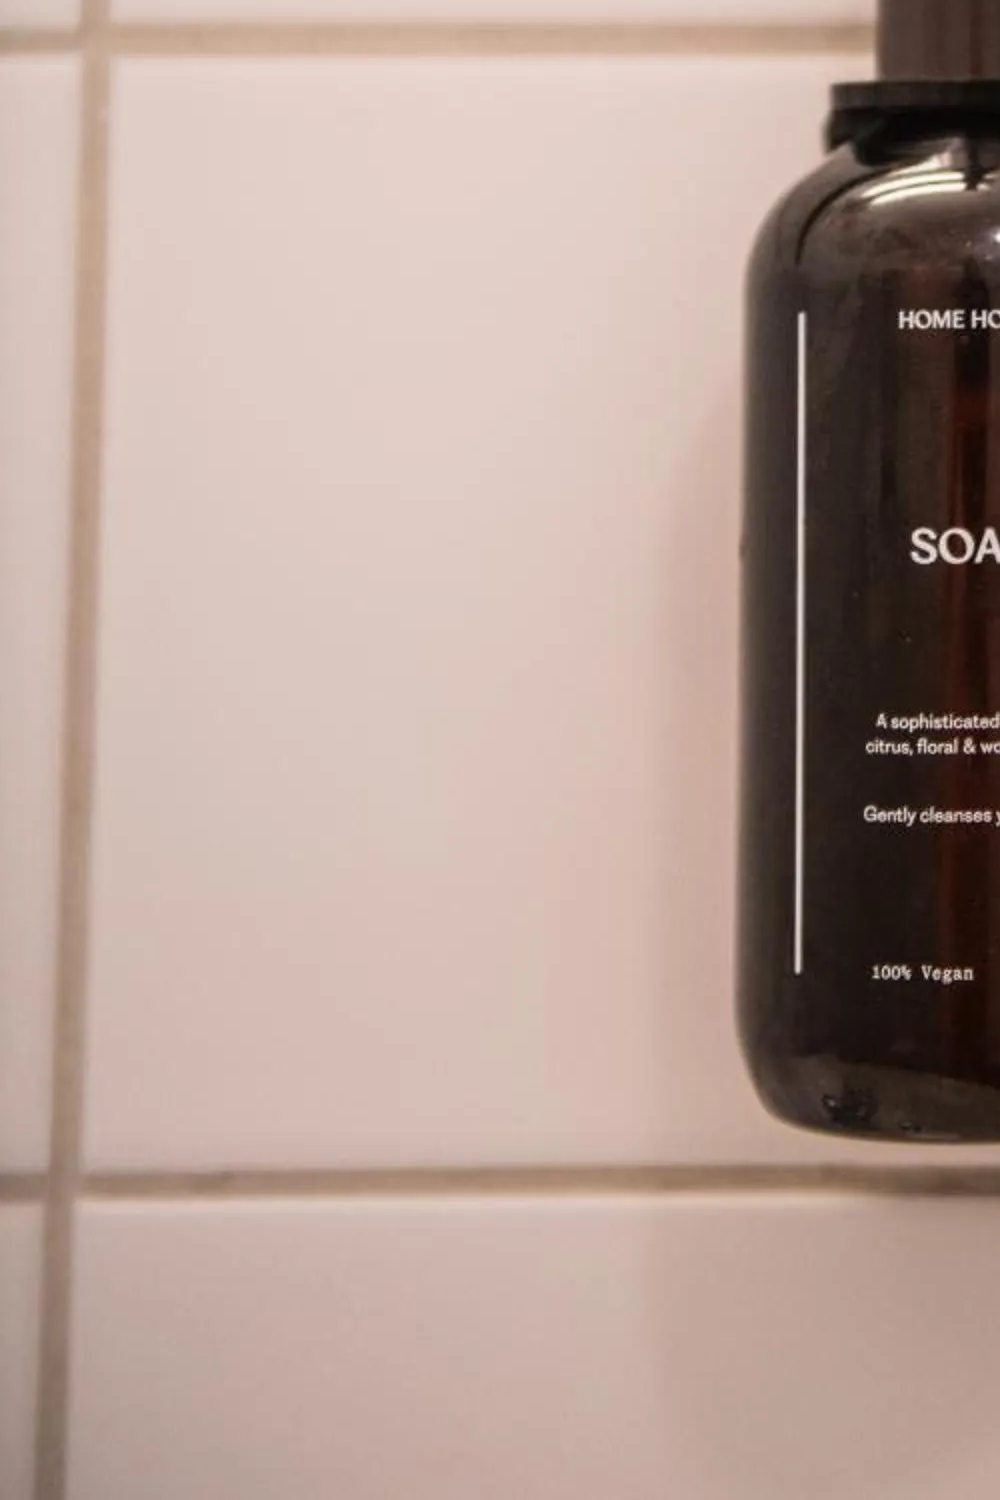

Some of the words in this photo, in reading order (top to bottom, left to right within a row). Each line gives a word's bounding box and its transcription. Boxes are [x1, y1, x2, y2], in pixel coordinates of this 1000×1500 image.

[898, 309, 965, 330] HOME
[875, 713, 886, 728] A
[890, 711, 999, 732] sophisticated
[865, 738, 912, 755] citrus,
[917, 737, 958, 754] floral
[962, 736, 976, 754] &
[863, 804, 916, 826] Gently
[919, 805, 992, 823] cleanses
[872, 964, 911, 981] 100%
[921, 964, 974, 984] Vegan
